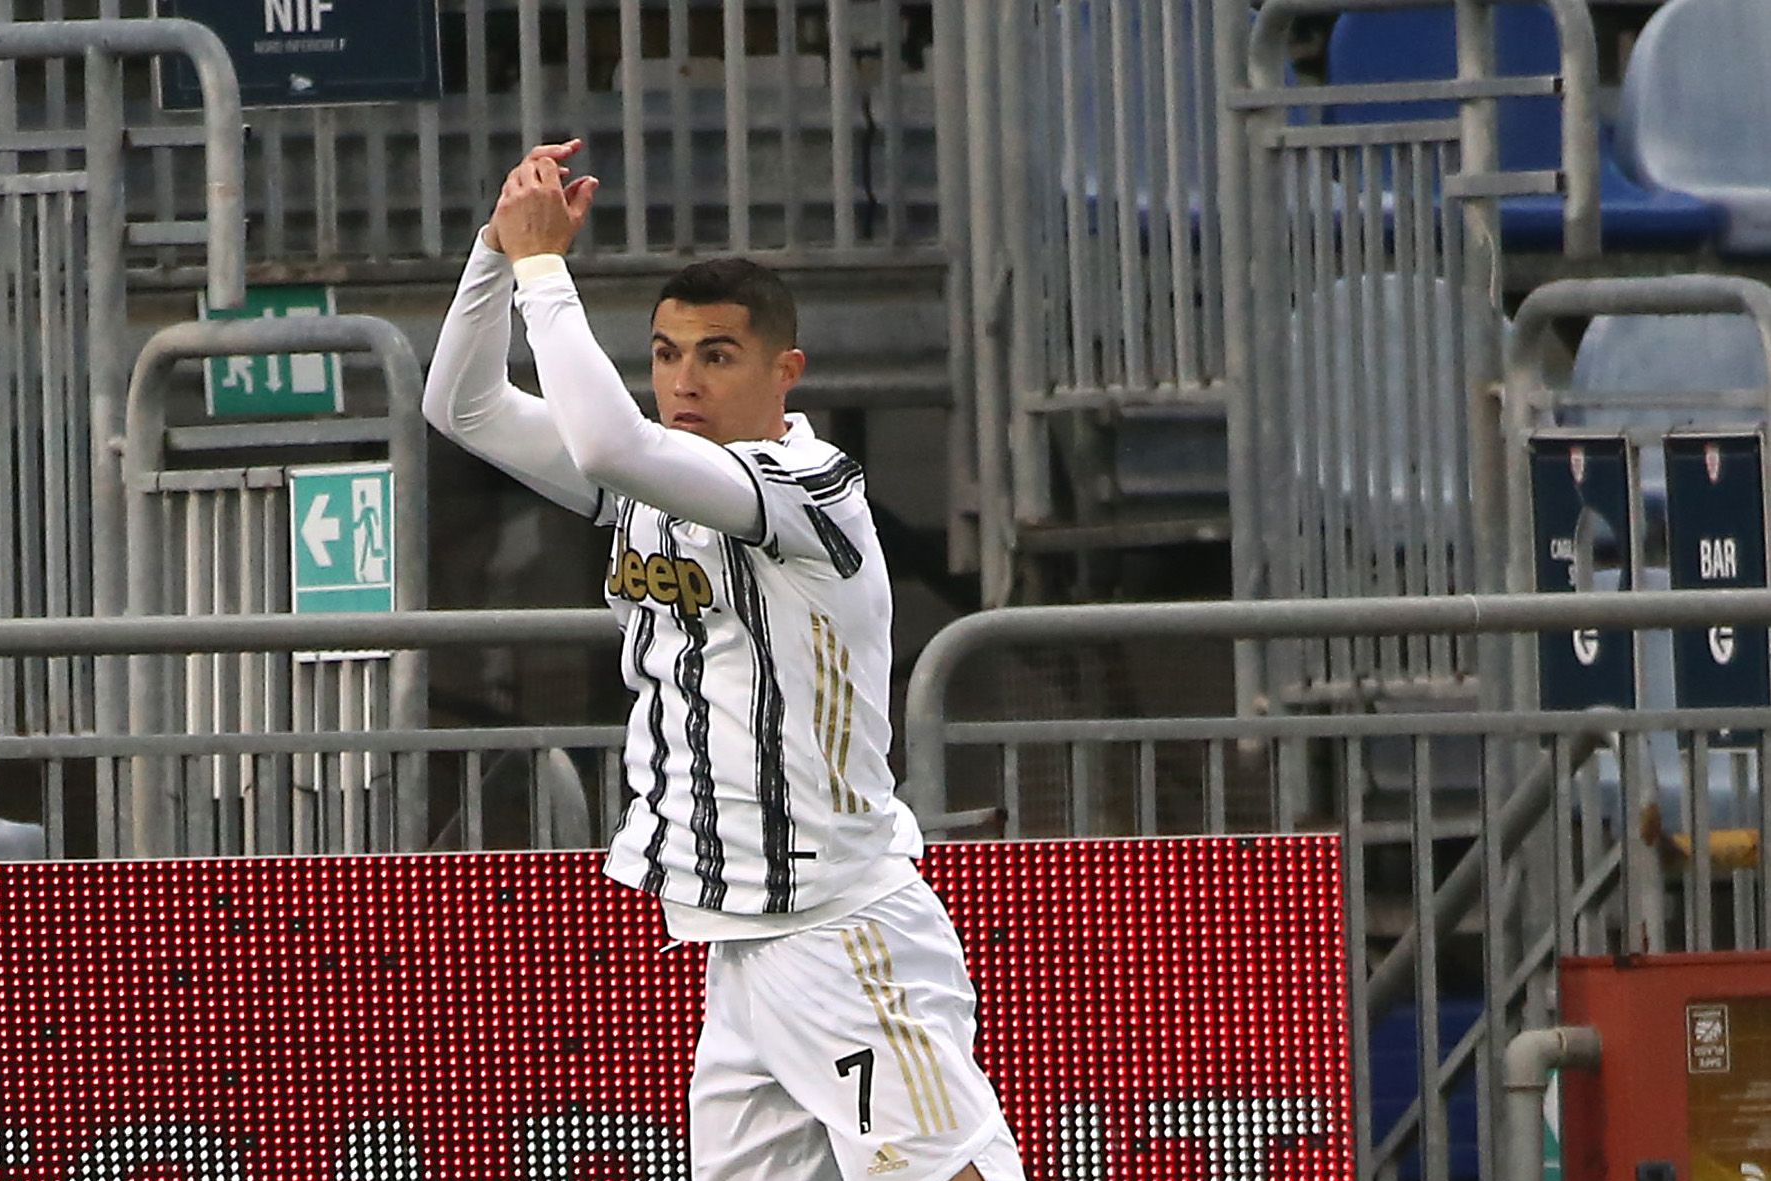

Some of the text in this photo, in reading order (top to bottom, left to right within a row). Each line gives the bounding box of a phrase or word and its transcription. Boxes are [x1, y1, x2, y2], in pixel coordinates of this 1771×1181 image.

[607, 529, 714, 618] Jeep
[1699, 537, 1738, 580] BAR
[835, 1047, 875, 1136] 7
